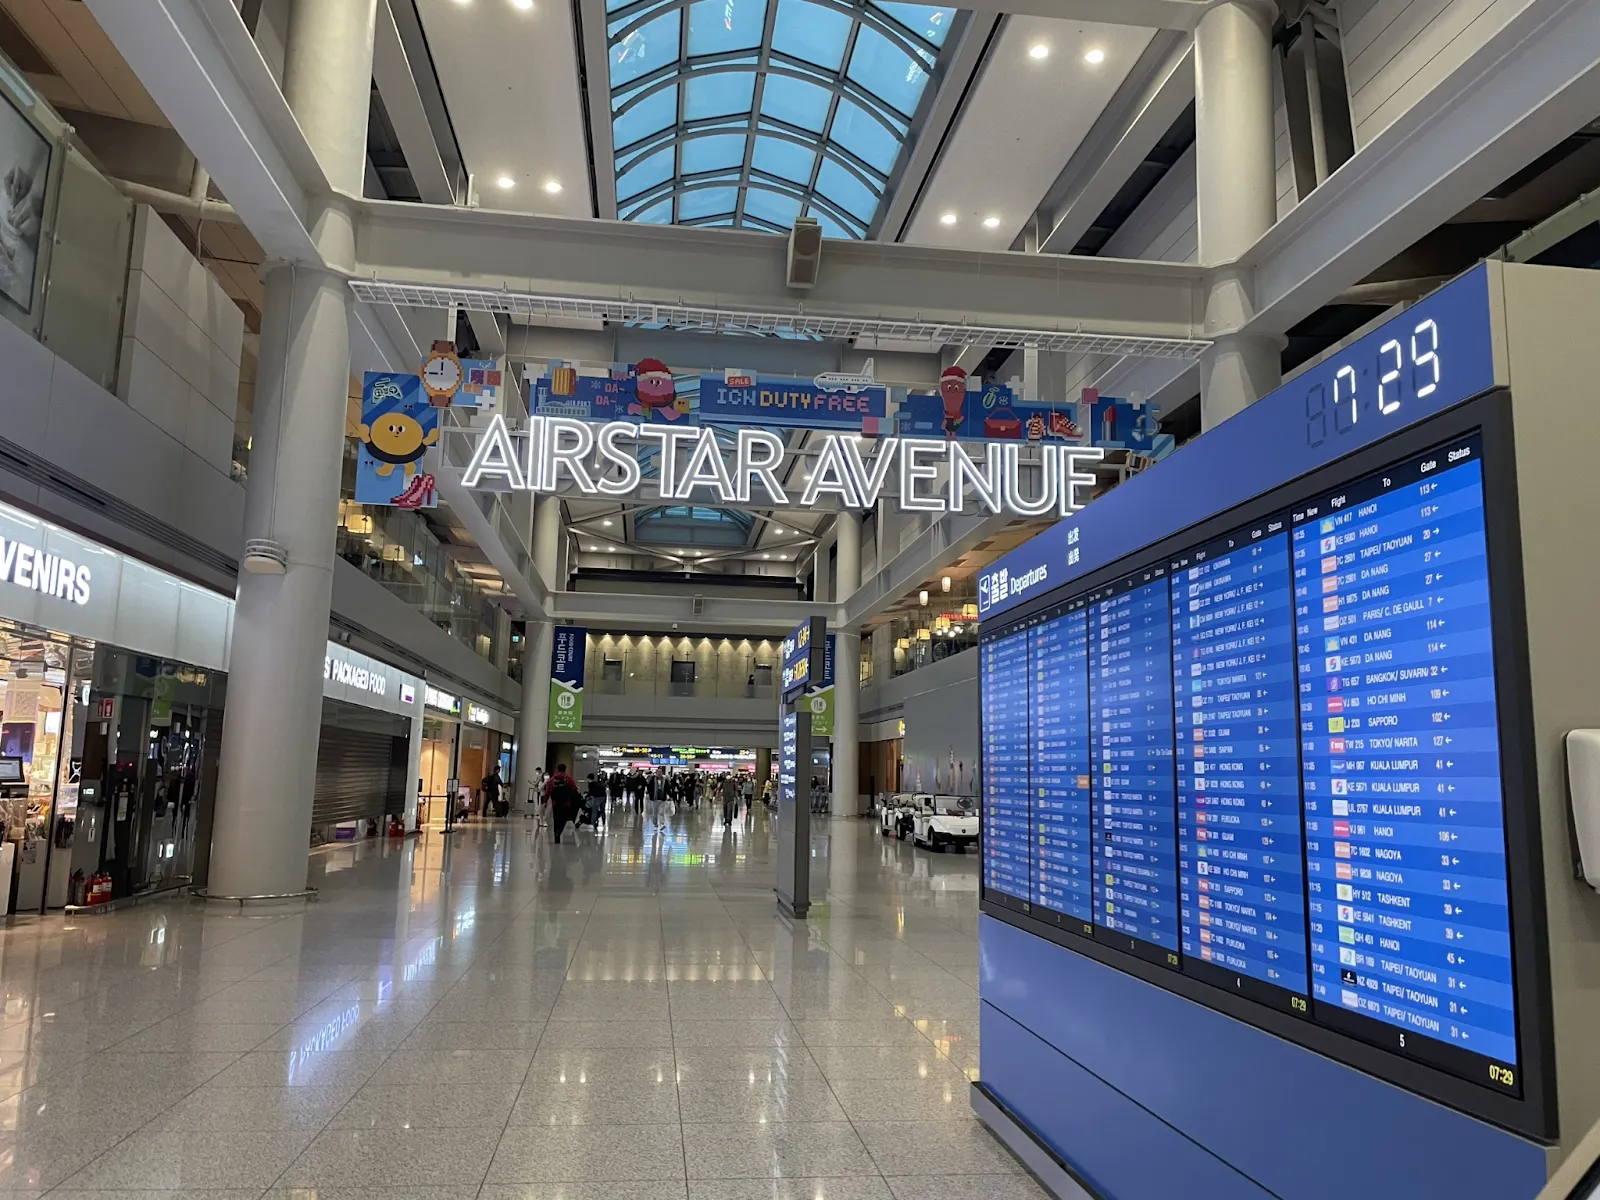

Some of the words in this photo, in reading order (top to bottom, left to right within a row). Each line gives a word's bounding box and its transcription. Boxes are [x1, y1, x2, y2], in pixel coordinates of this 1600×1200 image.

[728, 377, 750, 385] SALE
[760, 390, 810, 409] DUTY
[814, 394, 870, 413] FREE
[461, 413, 790, 504] AIRSTAR
[800, 434, 1105, 517] AVENUE
[1382, 477, 1391, 488] To
[1420, 459, 1437, 473] Gate
[1448, 446, 1471, 463] Status
[1357, 502, 1377, 518] HANOI
[1419, 482, 1430, 496] 113
[1358, 523, 1378, 538] HANOI
[1420, 505, 1431, 518] 113
[1360, 543, 1381, 559] TAIPEI/
[1382, 533, 1412, 552] TAOYUAN
[1360, 568, 1370, 579] DA
[1370, 562, 1389, 577] NANG
[1423, 550, 1432, 562] 27
[991, 567, 1009, 604] 출발
[1010, 564, 1048, 595] Departures
[1361, 588, 1371, 600] DA
[1371, 584, 1390, 598] NANG
[1424, 573, 1433, 585] 27
[1362, 607, 1384, 621] PARIS/
[1392, 603, 1402, 615] DE
[1363, 631, 1373, 642] DA
[1372, 627, 1392, 640] NANG
[1426, 618, 1437, 630] 114
[555, 632, 567, 673] 푸드코트
[1364, 652, 1374, 663] DA
[1374, 649, 1392, 661] NANG
[1427, 641, 1438, 653] 114
[332, 659, 369, 690] PACKAGED
[369, 672, 386, 695] FOOD
[1365, 670, 1398, 684] BANGKOK/
[1429, 664, 1438, 676] 32
[1366, 695, 1377, 705] HO
[1376, 693, 1388, 704] CHI
[1388, 691, 1406, 703] MINH
[1367, 714, 1398, 727] SAPPORO
[1431, 711, 1443, 723] 102
[1369, 737, 1393, 748] TOKYO/
[1393, 735, 1418, 747] NARITA
[1432, 734, 1444, 746] 127
[1369, 760, 1390, 770] KUALA
[1390, 759, 1418, 770] LUMPUR
[1435, 759, 1443, 770] 41
[1371, 782, 1391, 792] KUALA
[1392, 782, 1420, 793] LUMPUR
[1436, 783, 1445, 793] 41
[1372, 803, 1393, 815] KUALA
[1393, 804, 1421, 816] LUMPUR
[1438, 806, 1446, 818] 41
[1373, 826, 1394, 837] HANOI
[1374, 847, 1402, 861] NAGOYA
[1375, 869, 1403, 884] NAGOYA
[1360, 889, 1371, 901] 512
[1376, 892, 1411, 908] TASHKENT
[1378, 914, 1412, 931] TASHKENT
[1379, 936, 1400, 951] HANOI
[1446, 951, 1455, 964] 45
[1381, 959, 1403, 975] TAIPEI/
[1404, 964, 1436, 984] TAOYUAN
[1447, 975, 1456, 989] 31
[1291, 997, 1307, 1011] 07:29
[1382, 981, 1405, 998] TAIPEI/
[1405, 988, 1437, 1008] TAOYUAN
[1448, 1000, 1457, 1014] 31
[1383, 1004, 1406, 1022] TAIPEI/
[1407, 1011, 1438, 1032] TAOYUAN
[1449, 1024, 1458, 1038] 31
[1399, 1034, 1405, 1047] 5
[1489, 1064, 1514, 1086] 07:29
